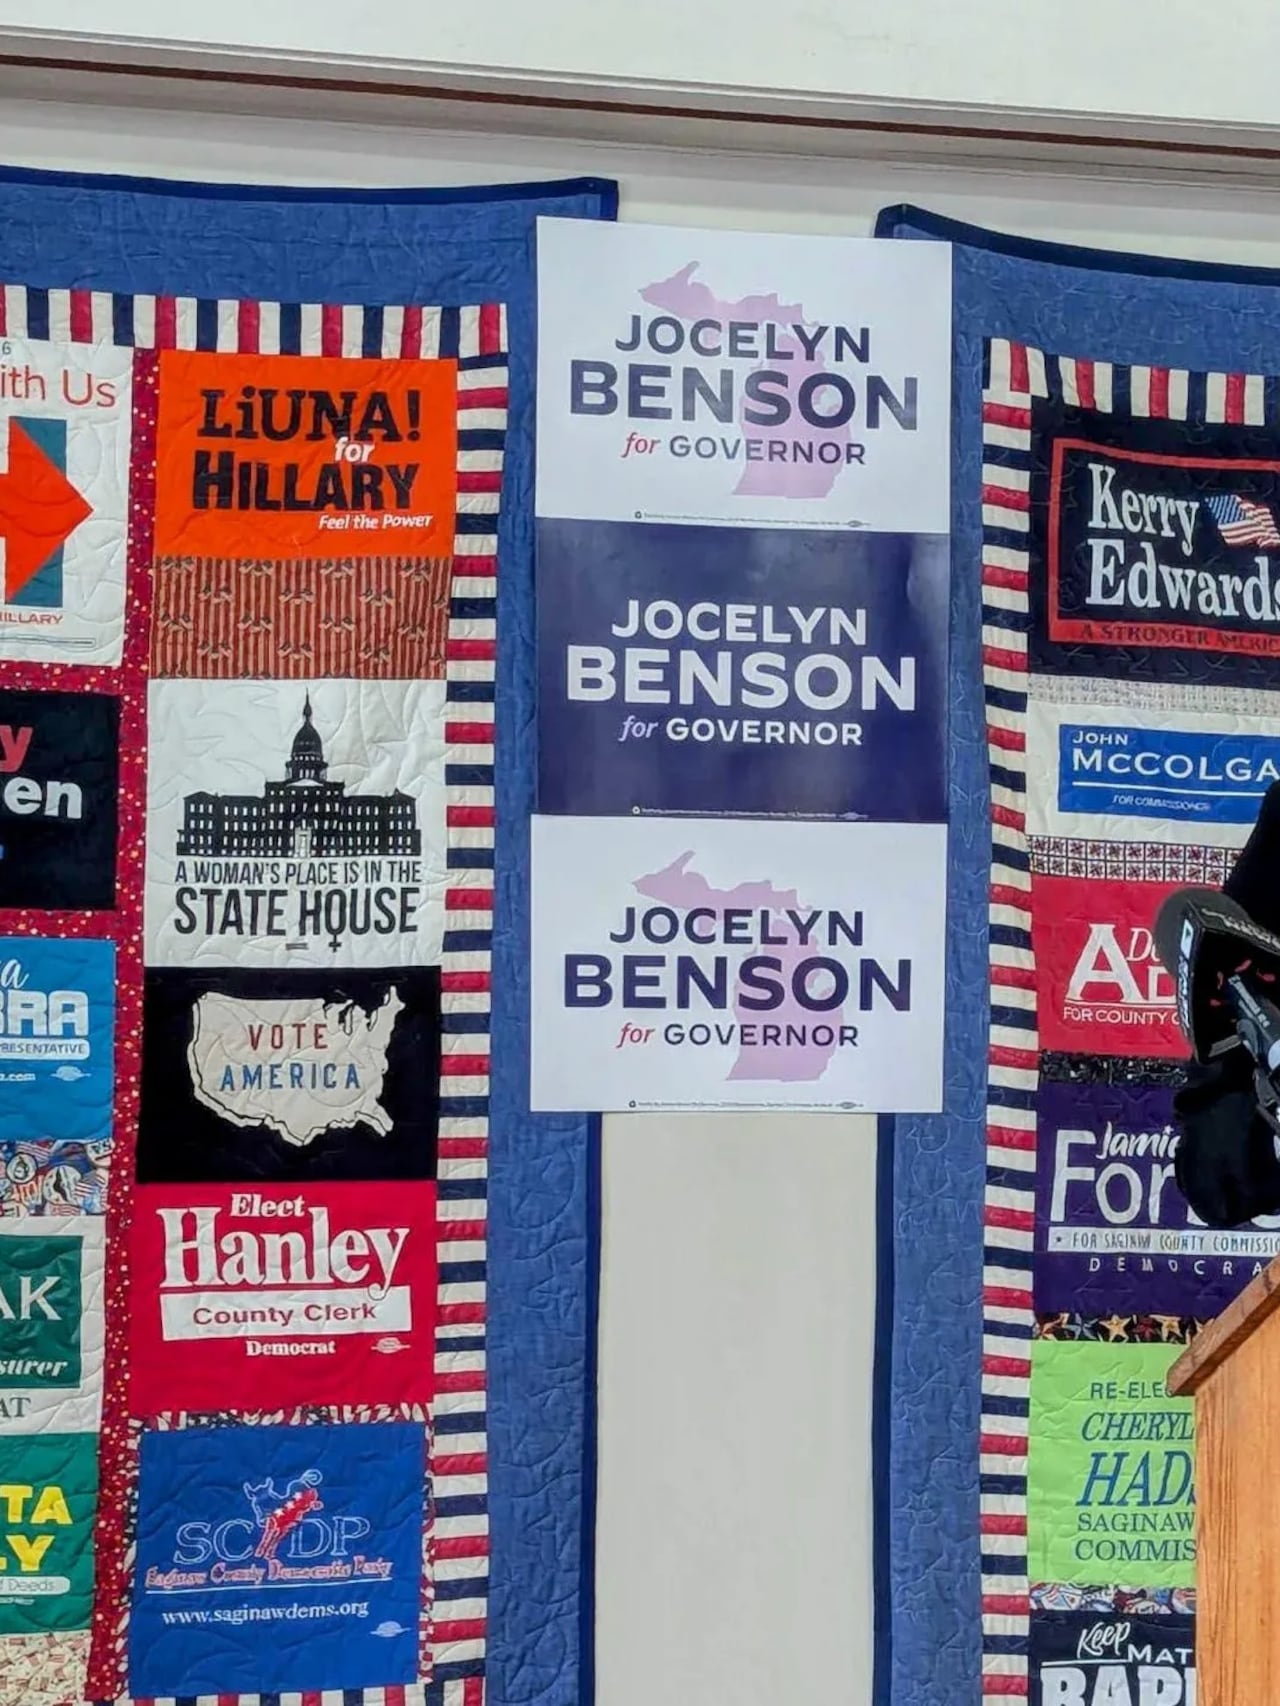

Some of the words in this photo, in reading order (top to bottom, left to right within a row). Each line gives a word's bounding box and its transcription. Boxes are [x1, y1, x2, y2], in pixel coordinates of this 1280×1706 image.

[615, 315, 870, 363] JOCELYN
[63, 369, 115, 408] Us
[570, 359, 918, 431] BENSON
[333, 436, 375, 464] for
[621, 432, 661, 458] for
[669, 435, 866, 464] GOVERNOR
[193, 449, 420, 511] HILLARY
[319, 514, 351, 530] Feel
[352, 514, 378, 529] the
[382, 513, 434, 528] Power
[1087, 462, 1200, 556] Kerry
[612, 600, 867, 645] JOCELYN
[1081, 624, 1094, 638] A
[1100, 624, 1209, 645] STRONGER
[567, 645, 916, 711] BENSON
[618, 716, 659, 742] for
[667, 717, 862, 745] GOVERNOR
[1072, 730, 1129, 746] JOHN
[4, 777, 82, 819] en
[175, 861, 187, 883] A
[194, 862, 280, 884] WOMAN'S
[285, 862, 337, 884] PLACE
[344, 862, 360, 884] IS
[364, 862, 382, 883] IN
[387, 861, 422, 883] THE
[174, 887, 288, 936] STATE
[300, 887, 420, 937] HOUSE
[610, 906, 863, 946] JOCELYN
[564, 954, 911, 1012] BENSON
[0, 989, 89, 1037] RA
[1063, 1007, 1093, 1021] FOR
[1095, 1010, 1169, 1025] COUNTY
[248, 1024, 328, 1051] VOTE
[617, 1022, 655, 1049] for
[664, 1024, 859, 1047] GOVERNOR
[219, 1063, 360, 1091] AMERICA
[230, 1193, 305, 1217] Elect
[156, 1206, 410, 1300] Hanley
[1073, 1233, 1097, 1248] FOR
[1160, 1234, 1204, 1250] COUNTY
[193, 1307, 293, 1327] County
[304, 1303, 376, 1321] Clerk
[247, 1340, 335, 1356] Democrat
[1081, 1412, 1195, 1442] CHERYL
[1075, 1450, 1196, 1507] HAD
[0, 1535, 55, 1572] Y
[162, 1601, 370, 1625] www.saginawdems.org
[1077, 1622, 1130, 1659] Keep
[1128, 1644, 1193, 1665] MAT
